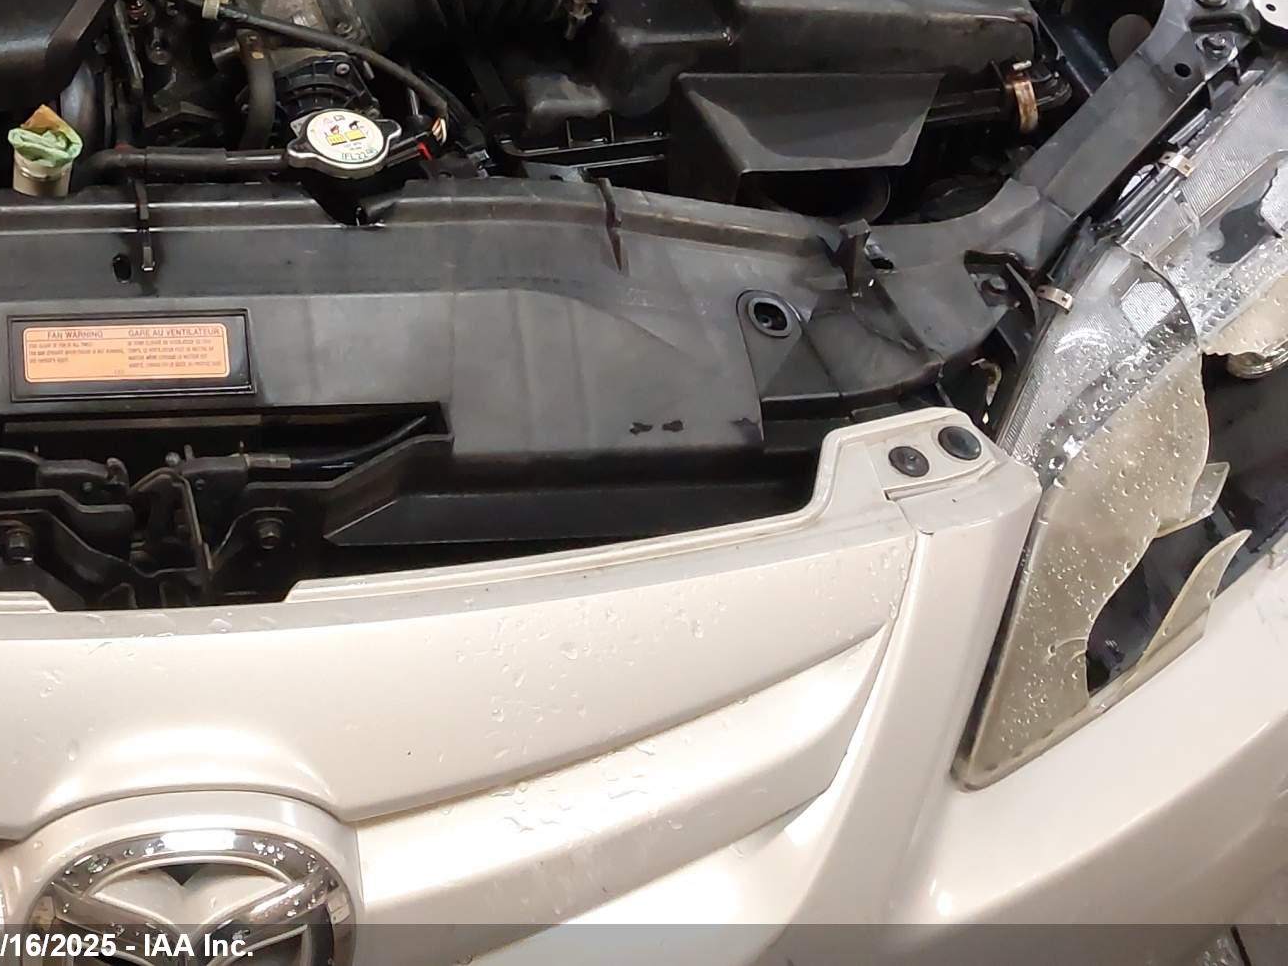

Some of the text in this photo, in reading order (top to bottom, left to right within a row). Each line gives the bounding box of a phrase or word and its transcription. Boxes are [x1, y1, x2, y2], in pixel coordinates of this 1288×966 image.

[47, 328, 104, 341] FAN WARNING
[127, 326, 221, 338] GARE AU VENTILATEUR
